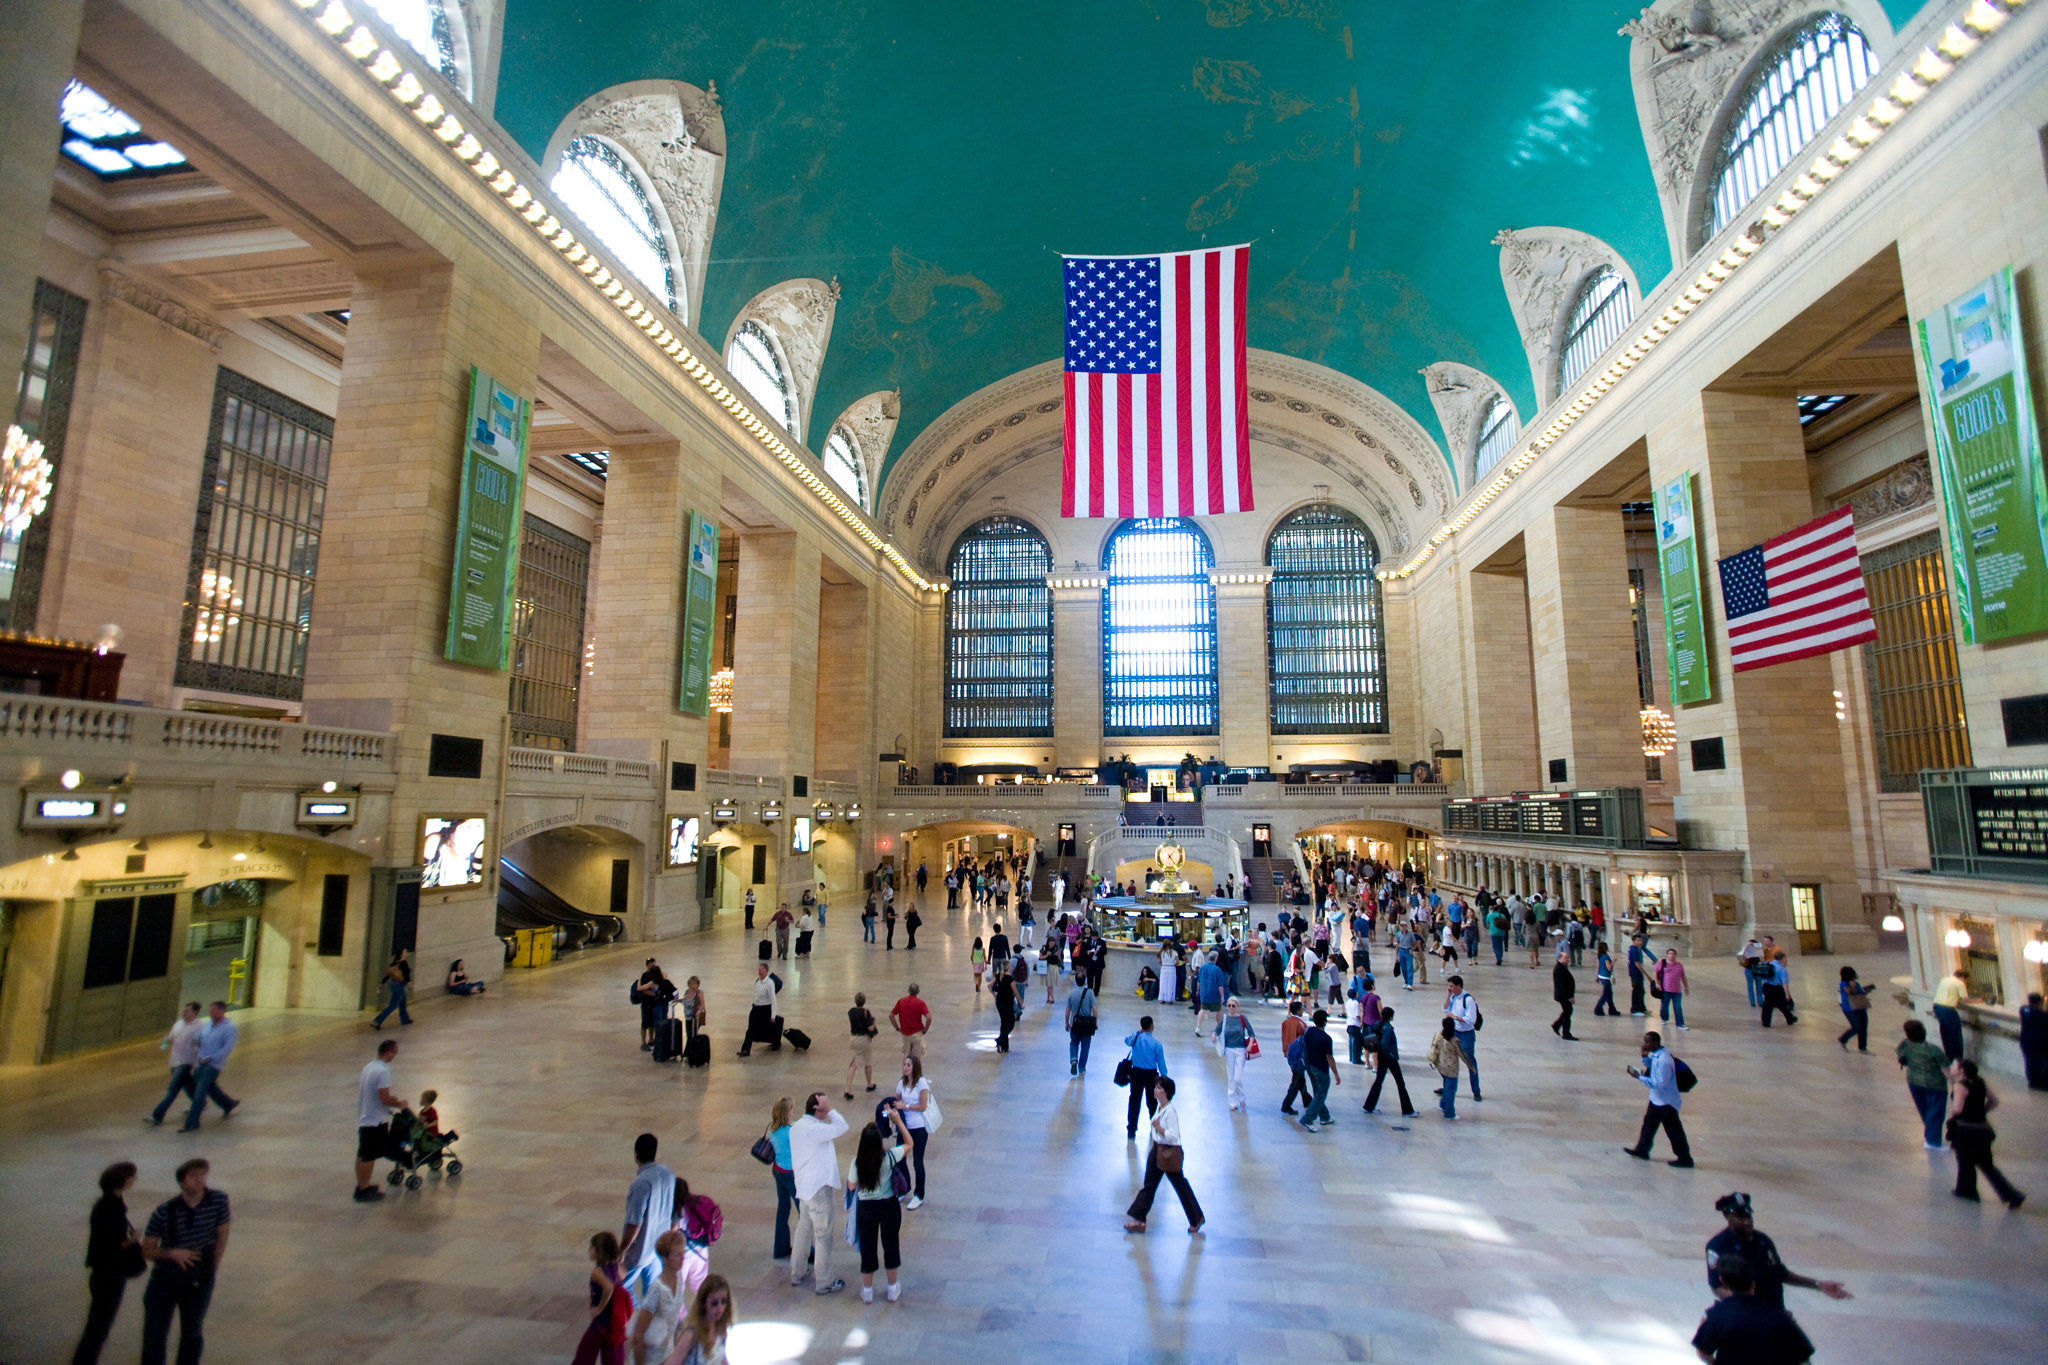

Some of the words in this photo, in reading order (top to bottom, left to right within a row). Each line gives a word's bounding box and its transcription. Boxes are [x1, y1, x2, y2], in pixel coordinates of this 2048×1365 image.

[1953, 393, 1993, 443] GOOD
[1993, 387, 2008, 425] &
[476, 463, 499, 501] GOOD
[1983, 601, 2006, 613] Home
[231, 863, 271, 875] TRACKS
[271, 864, 283, 873] 27
